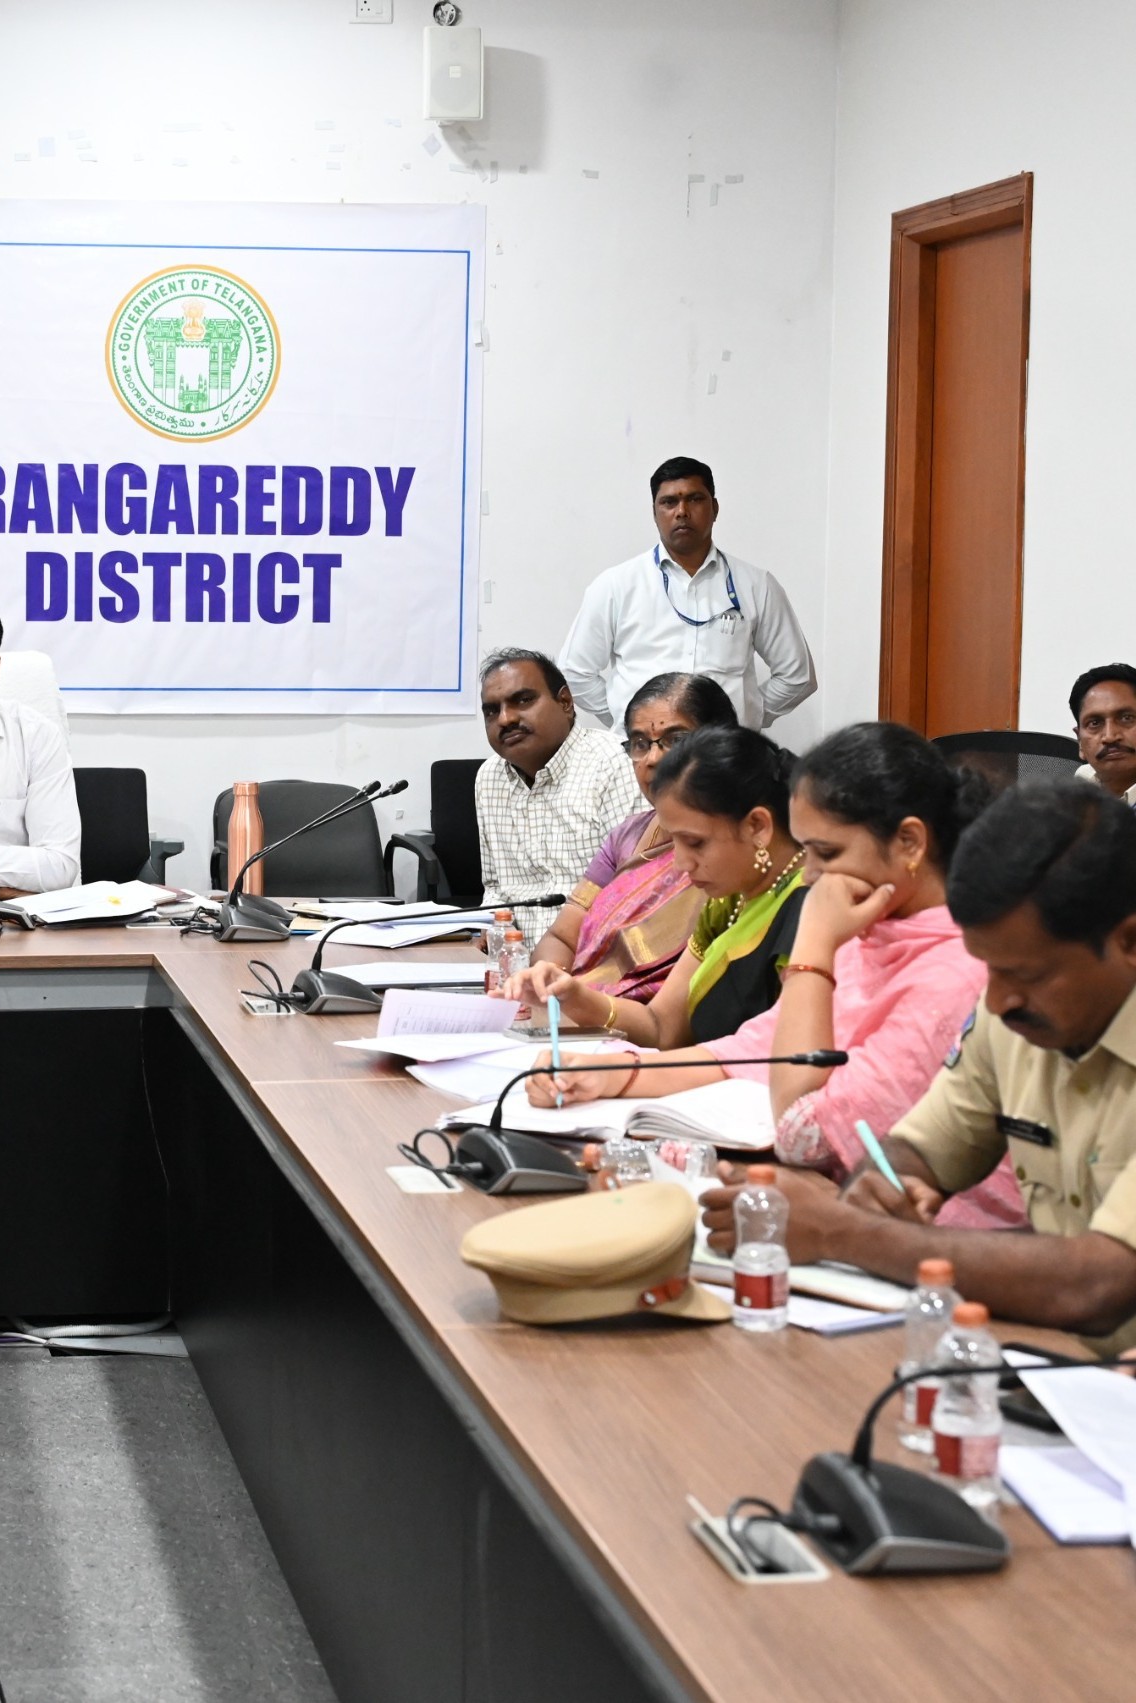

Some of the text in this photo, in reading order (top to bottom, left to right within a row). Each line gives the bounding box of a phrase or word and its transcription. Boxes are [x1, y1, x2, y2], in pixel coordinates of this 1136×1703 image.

[118, 278, 268, 354] GOVERNMENT OF TELANGANA
[25, 550, 342, 624] DISTRICT
